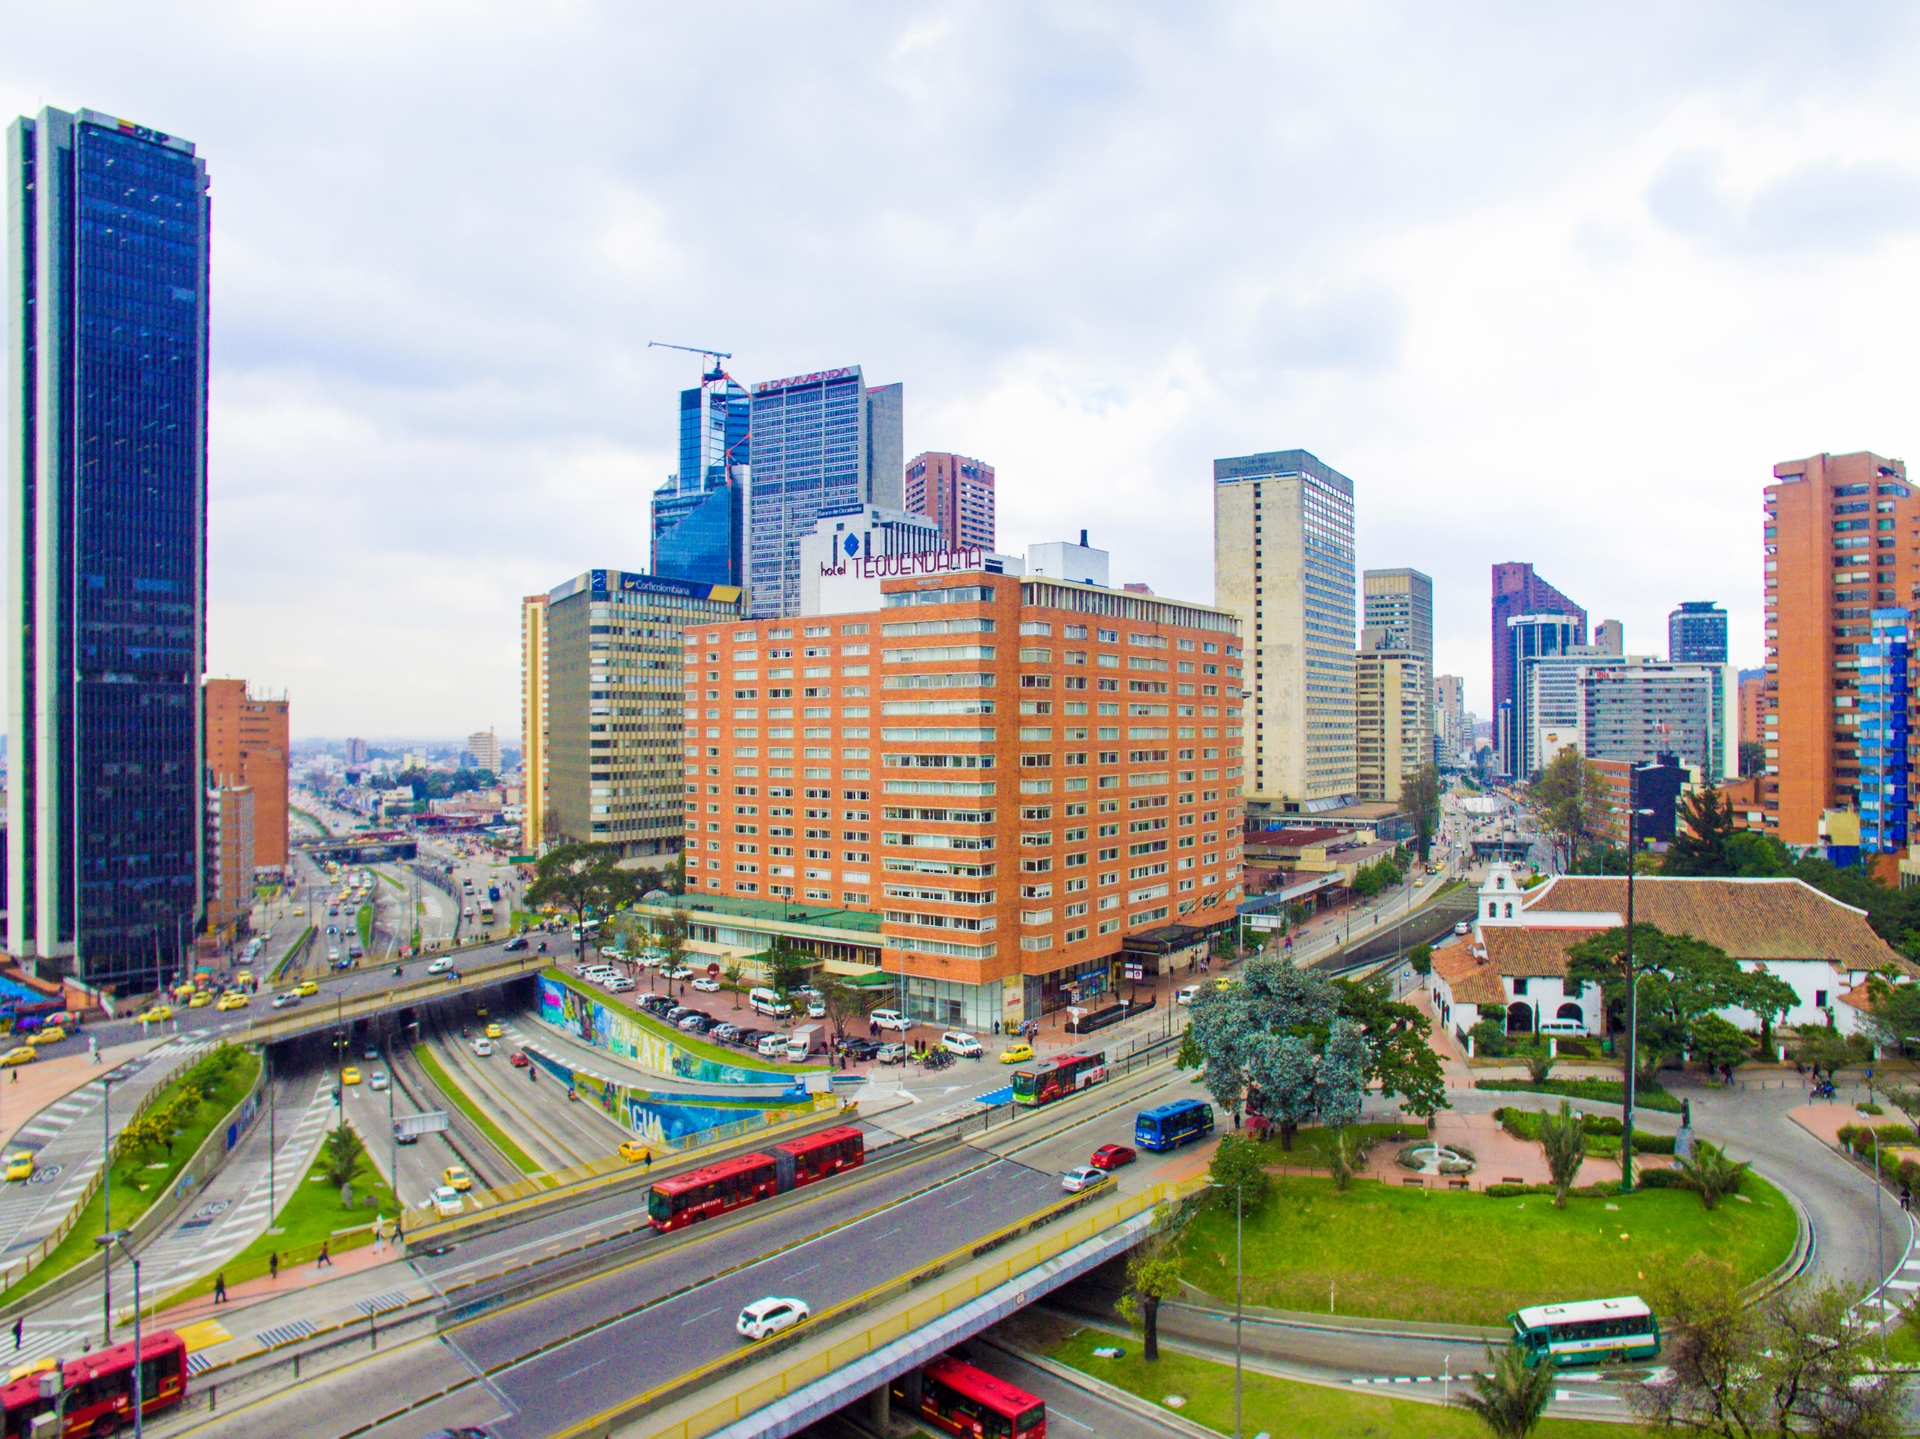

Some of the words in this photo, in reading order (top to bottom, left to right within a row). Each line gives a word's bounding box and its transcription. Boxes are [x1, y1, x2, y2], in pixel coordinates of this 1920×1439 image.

[770, 367, 851, 389] DAVIVIENDA
[818, 508, 832, 517] Banco
[839, 506, 862, 514] Occidente
[820, 559, 847, 577] hotel
[852, 545, 982, 579] TEQUENDAMA
[635, 579, 690, 595] Corficolombiana
[1596, 671, 1610, 679] ibis
